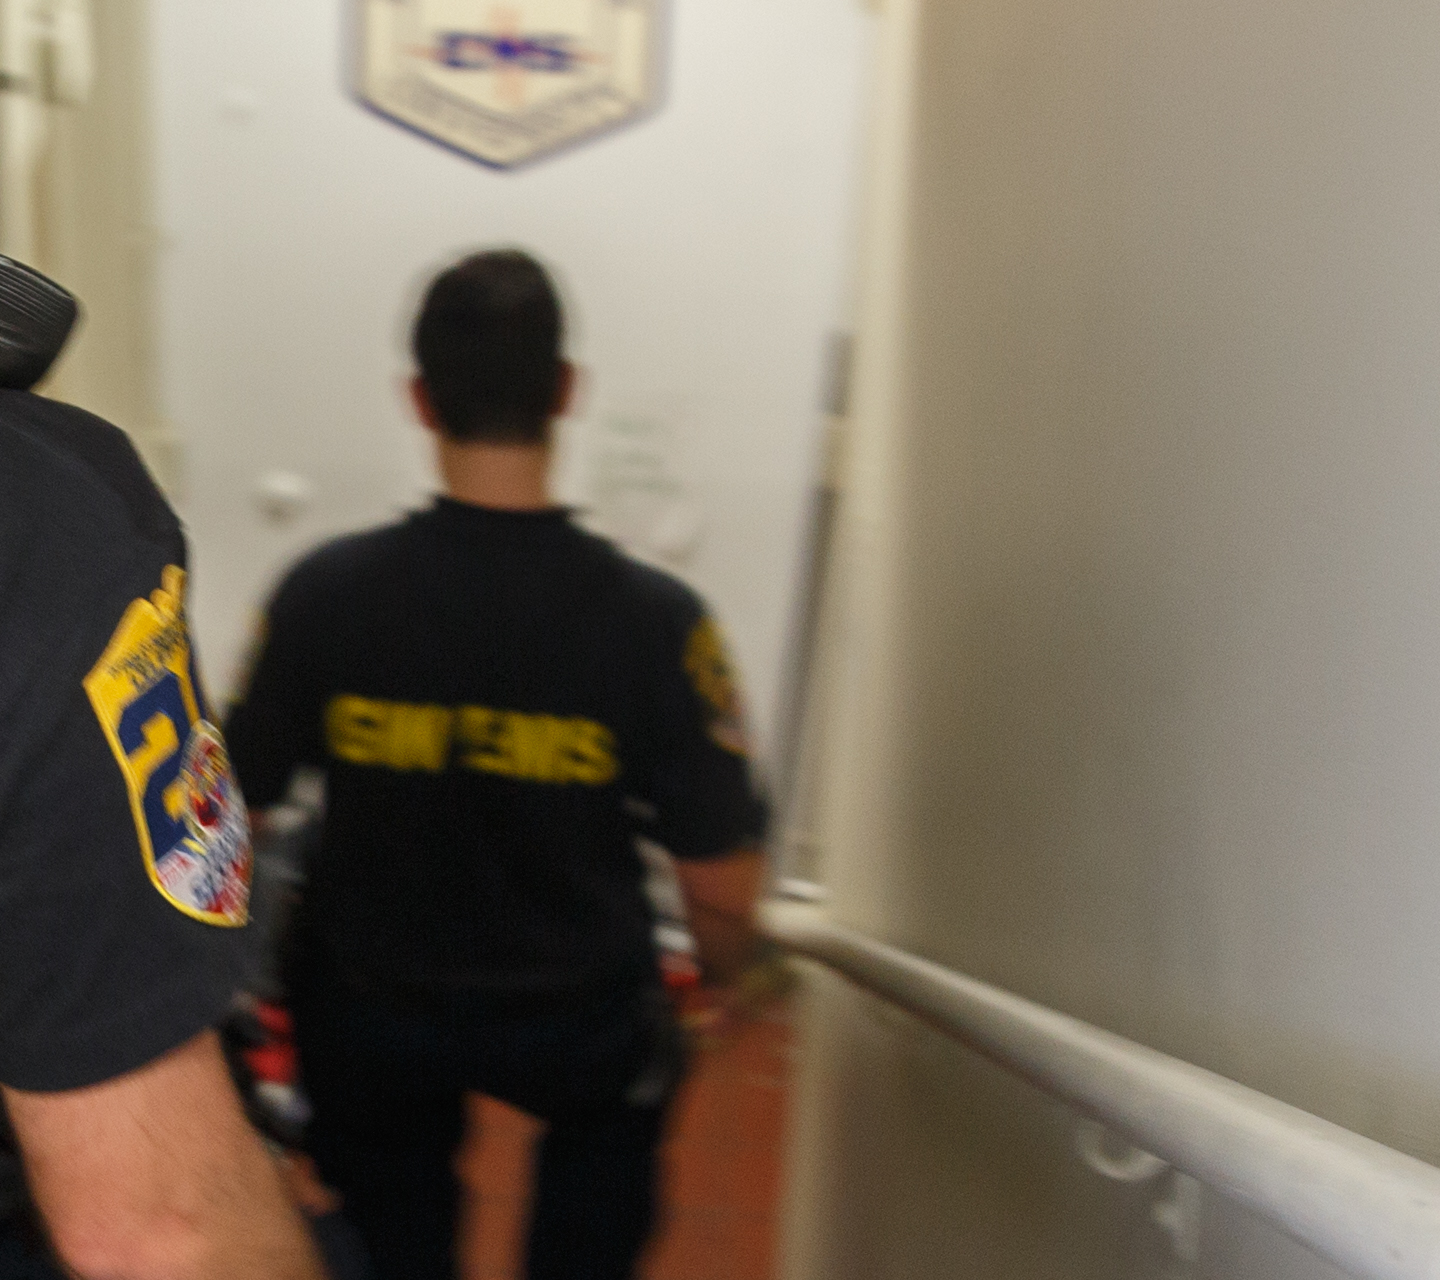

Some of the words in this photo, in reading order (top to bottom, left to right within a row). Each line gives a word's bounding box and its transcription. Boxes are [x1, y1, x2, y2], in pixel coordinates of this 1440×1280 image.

[119, 673, 207, 862] 2
[325, 693, 449, 773] GW
[456, 704, 619, 786] EMS
